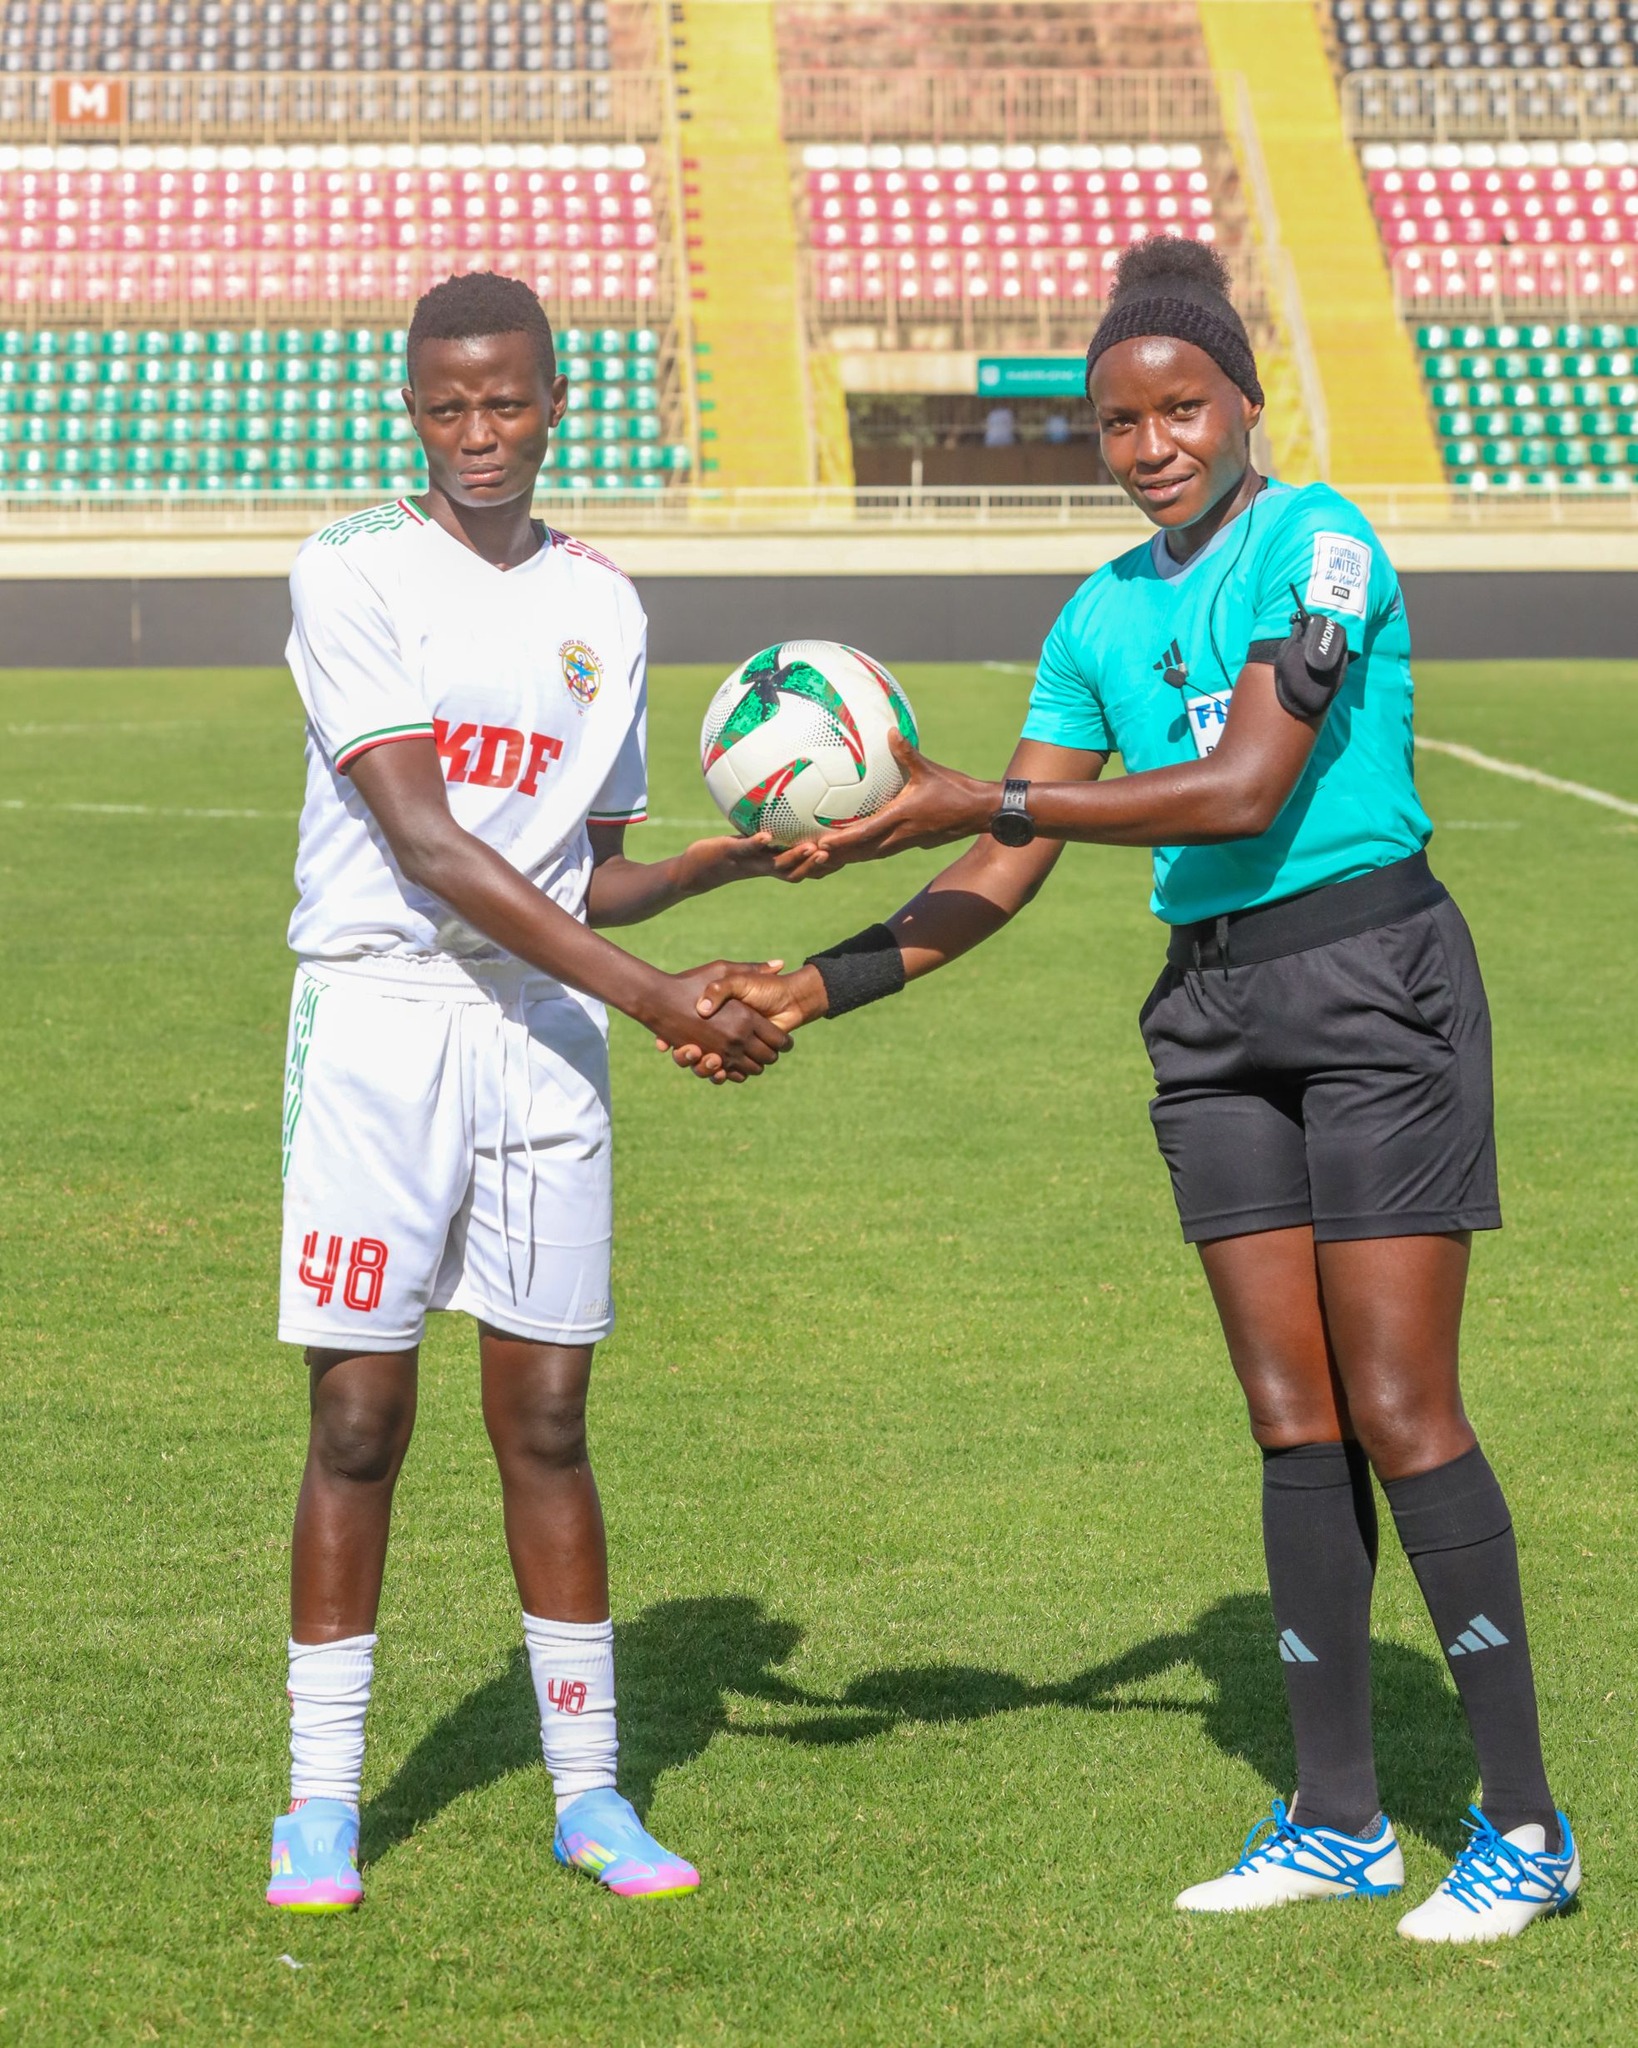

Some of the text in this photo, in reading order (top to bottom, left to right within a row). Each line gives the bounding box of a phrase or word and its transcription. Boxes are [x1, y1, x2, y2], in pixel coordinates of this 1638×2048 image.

[68, 82, 107, 119] M
[1329, 546, 1361, 564] FOOTBALL
[1329, 556, 1361, 577] UNITES
[1325, 570, 1361, 589] the World
[1332, 586, 1350, 599] FIFA
[1195, 698, 1232, 729] FI
[433, 718, 564, 797] KDF
[299, 1230, 388, 1312] 48
[548, 1678, 587, 1714] 48
